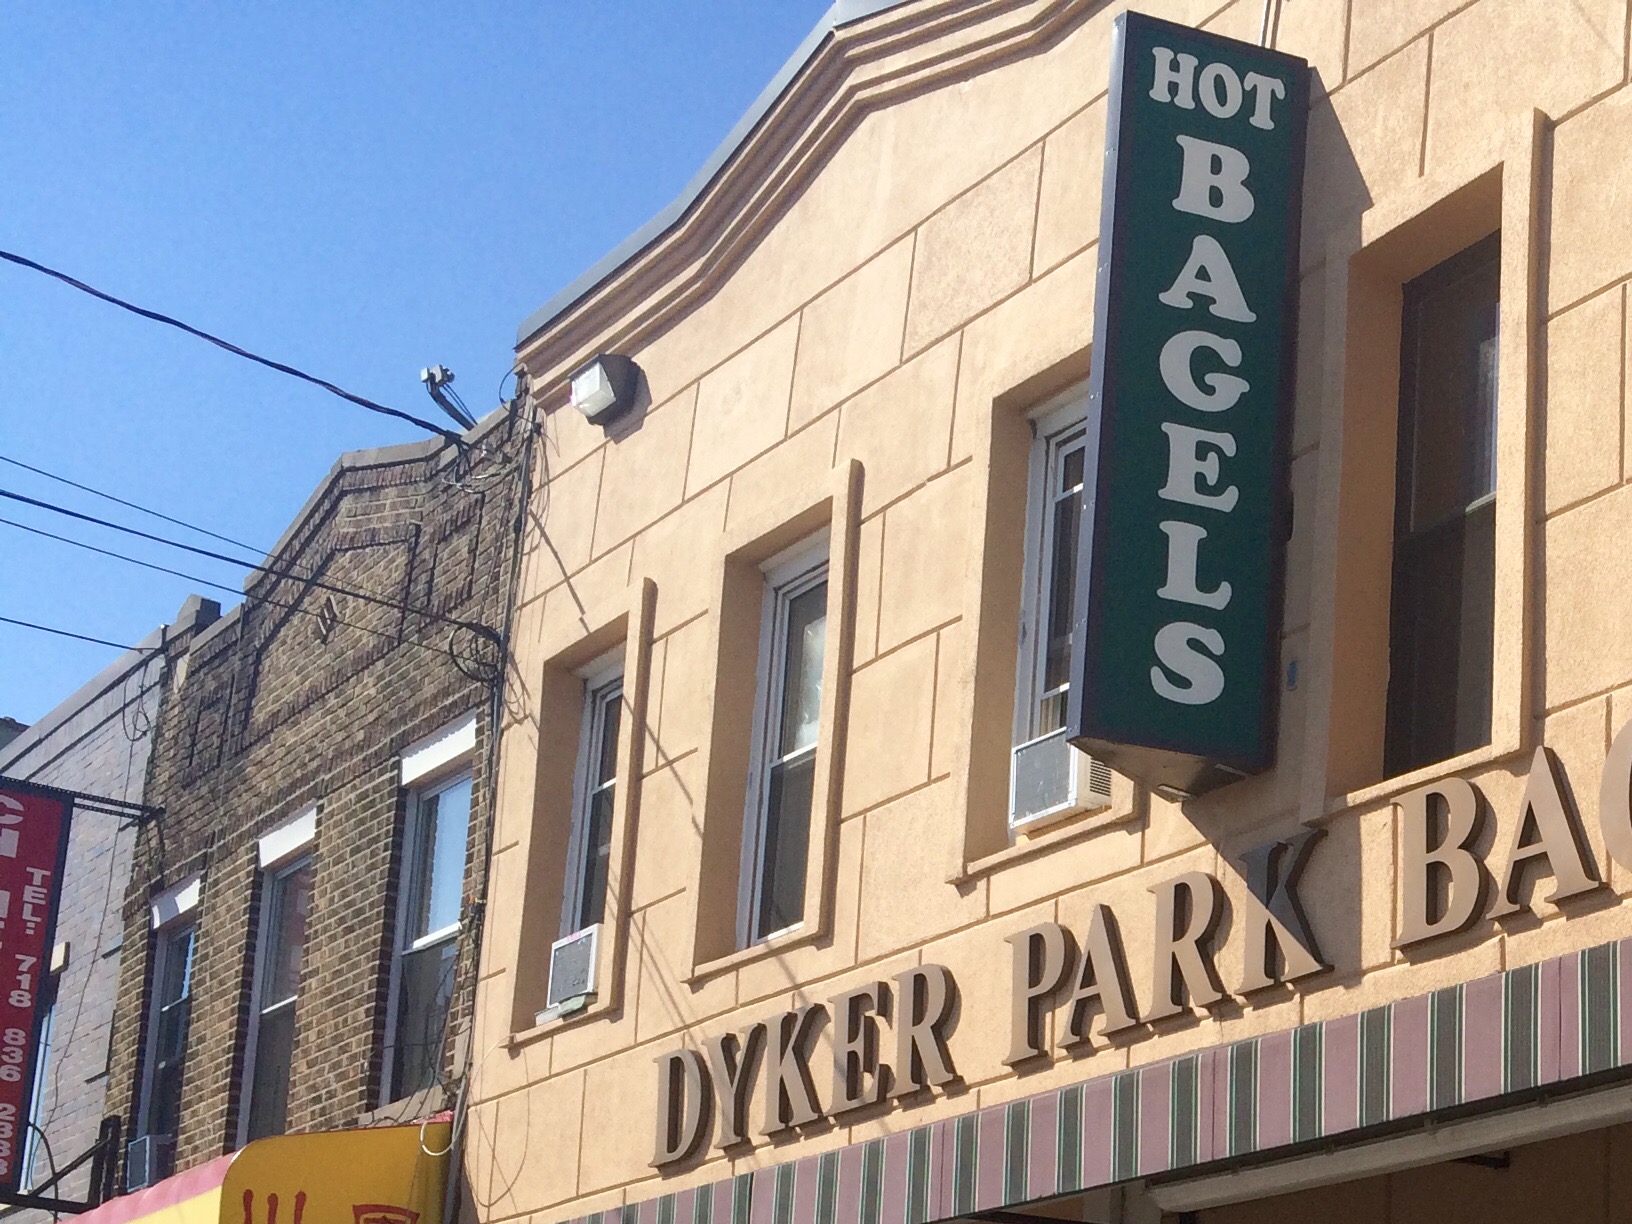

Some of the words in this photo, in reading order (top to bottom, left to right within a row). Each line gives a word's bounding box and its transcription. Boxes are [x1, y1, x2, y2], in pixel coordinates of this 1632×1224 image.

[1149, 46, 1286, 131] HOT
[1150, 133, 1257, 706] BAGELS
[22, 867, 51, 935] TEL:
[8, 954, 37, 1008] 718
[655, 965, 962, 1167] DYKER
[1005, 828, 1331, 1066] PARK
[0, 1028, 26, 1082] 836
